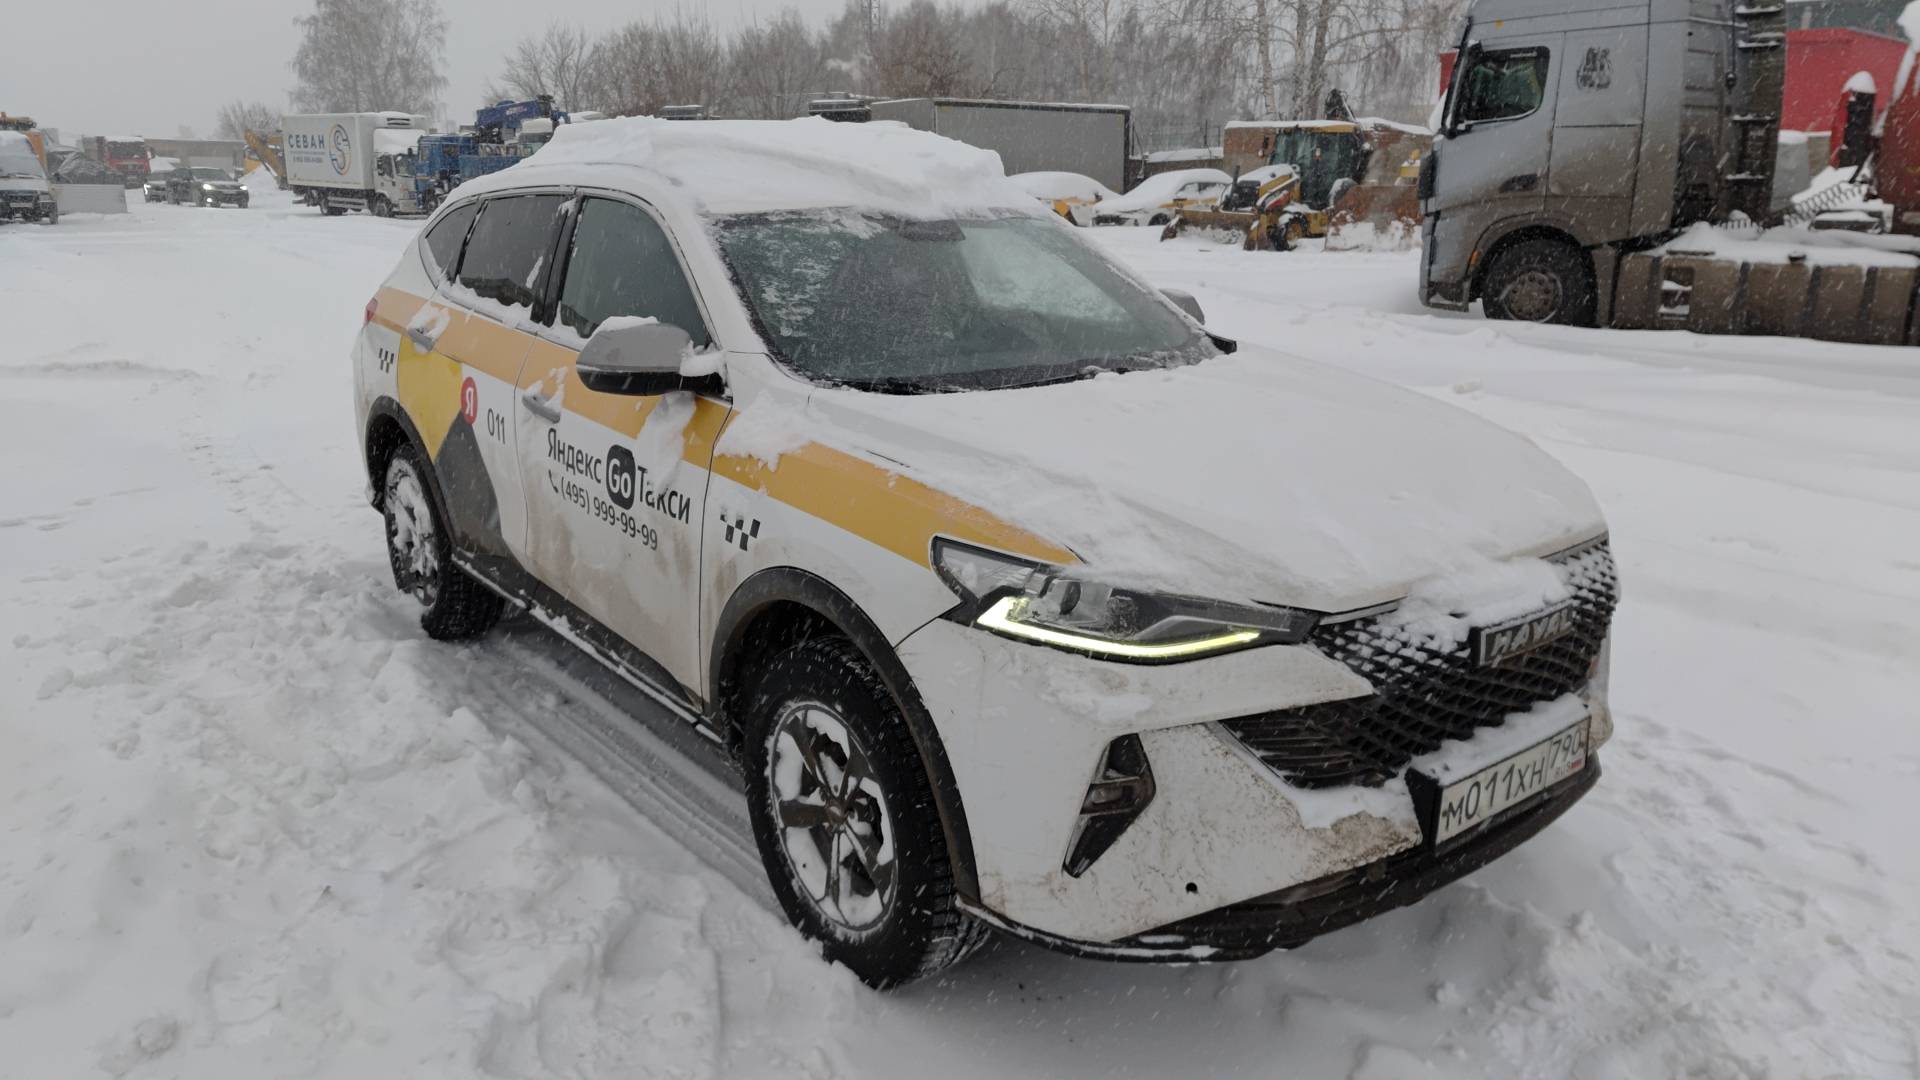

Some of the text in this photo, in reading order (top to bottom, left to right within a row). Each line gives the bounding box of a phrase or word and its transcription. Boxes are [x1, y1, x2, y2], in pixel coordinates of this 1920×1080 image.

[287, 134, 325, 149] СЕВАН
[465, 386, 474, 417] Я
[487, 408, 505, 445] 011
[547, 427, 602, 484] Яндекс
[608, 457, 632, 499] Go
[561, 476, 658, 551] (495) 999-99-99
[1490, 608, 1573, 657] HAVAL
[1551, 729, 1584, 769] 790
